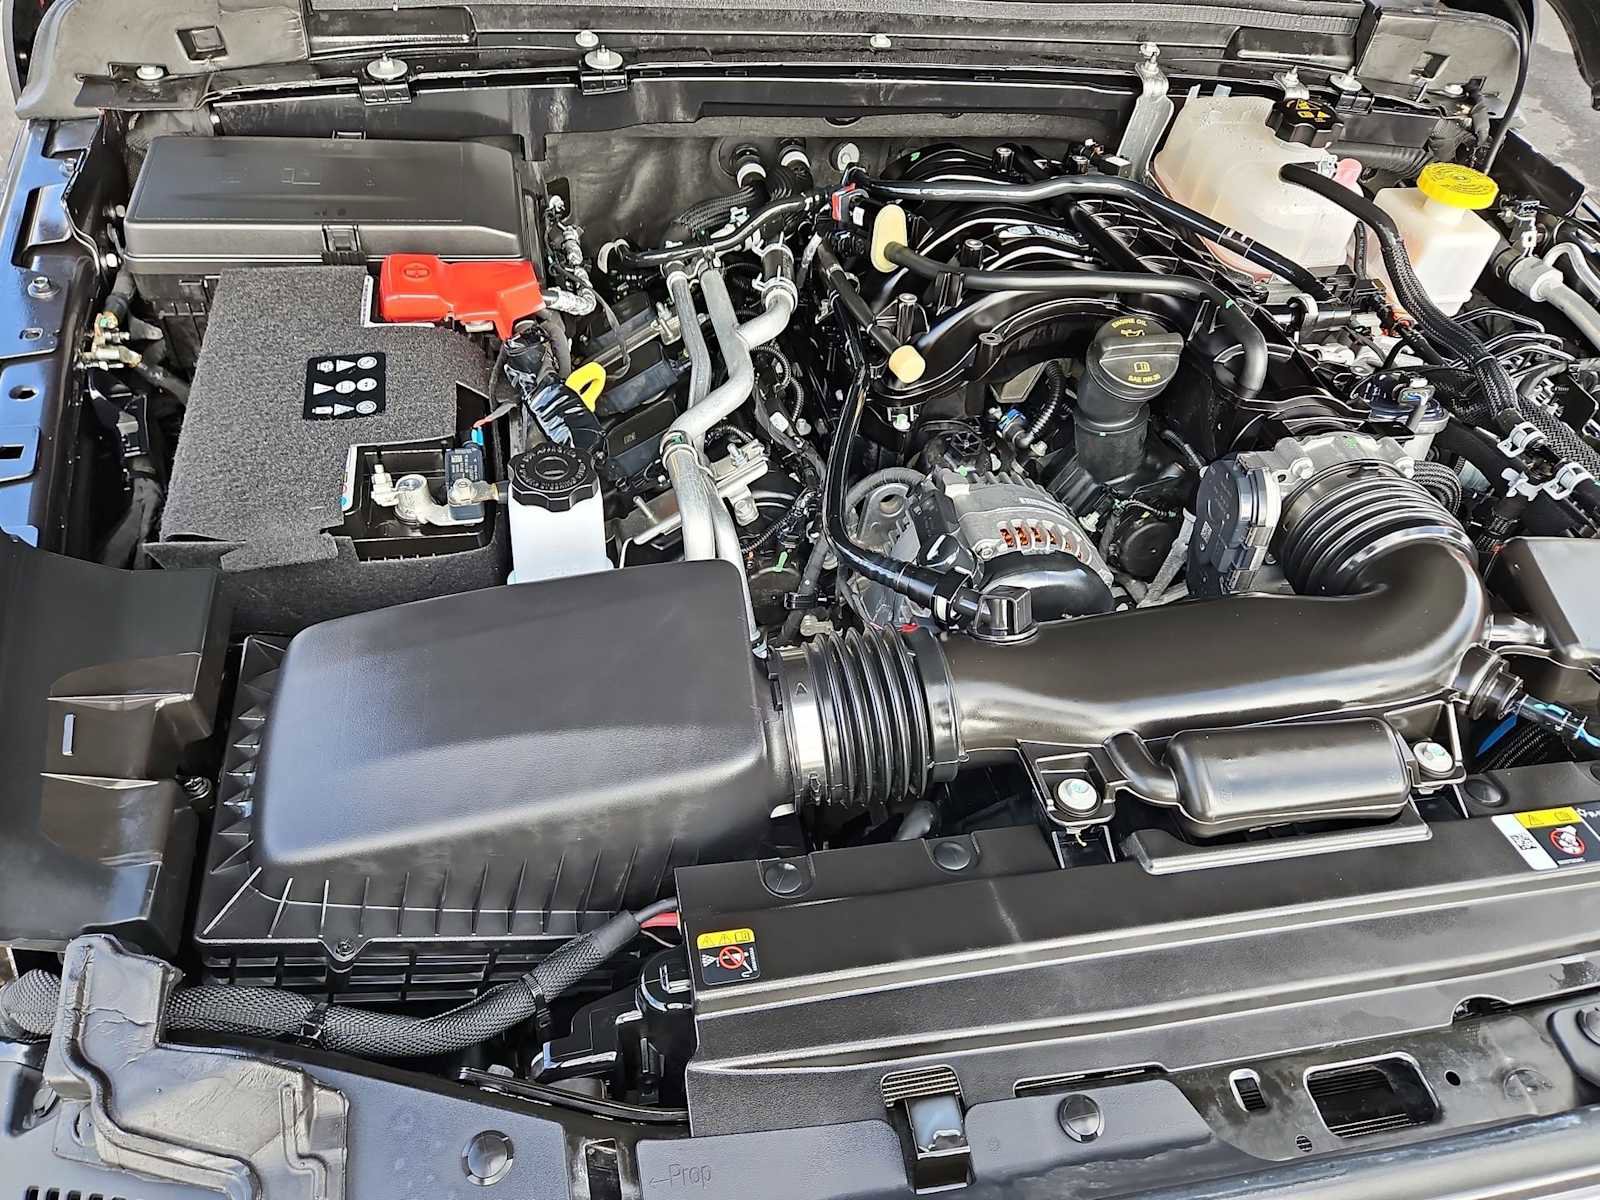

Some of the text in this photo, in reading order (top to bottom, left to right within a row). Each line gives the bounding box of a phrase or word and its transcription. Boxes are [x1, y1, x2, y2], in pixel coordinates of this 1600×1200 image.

[1111, 317, 1148, 328] ENGINE OIL
[668, 1163, 712, 1189] Prop
